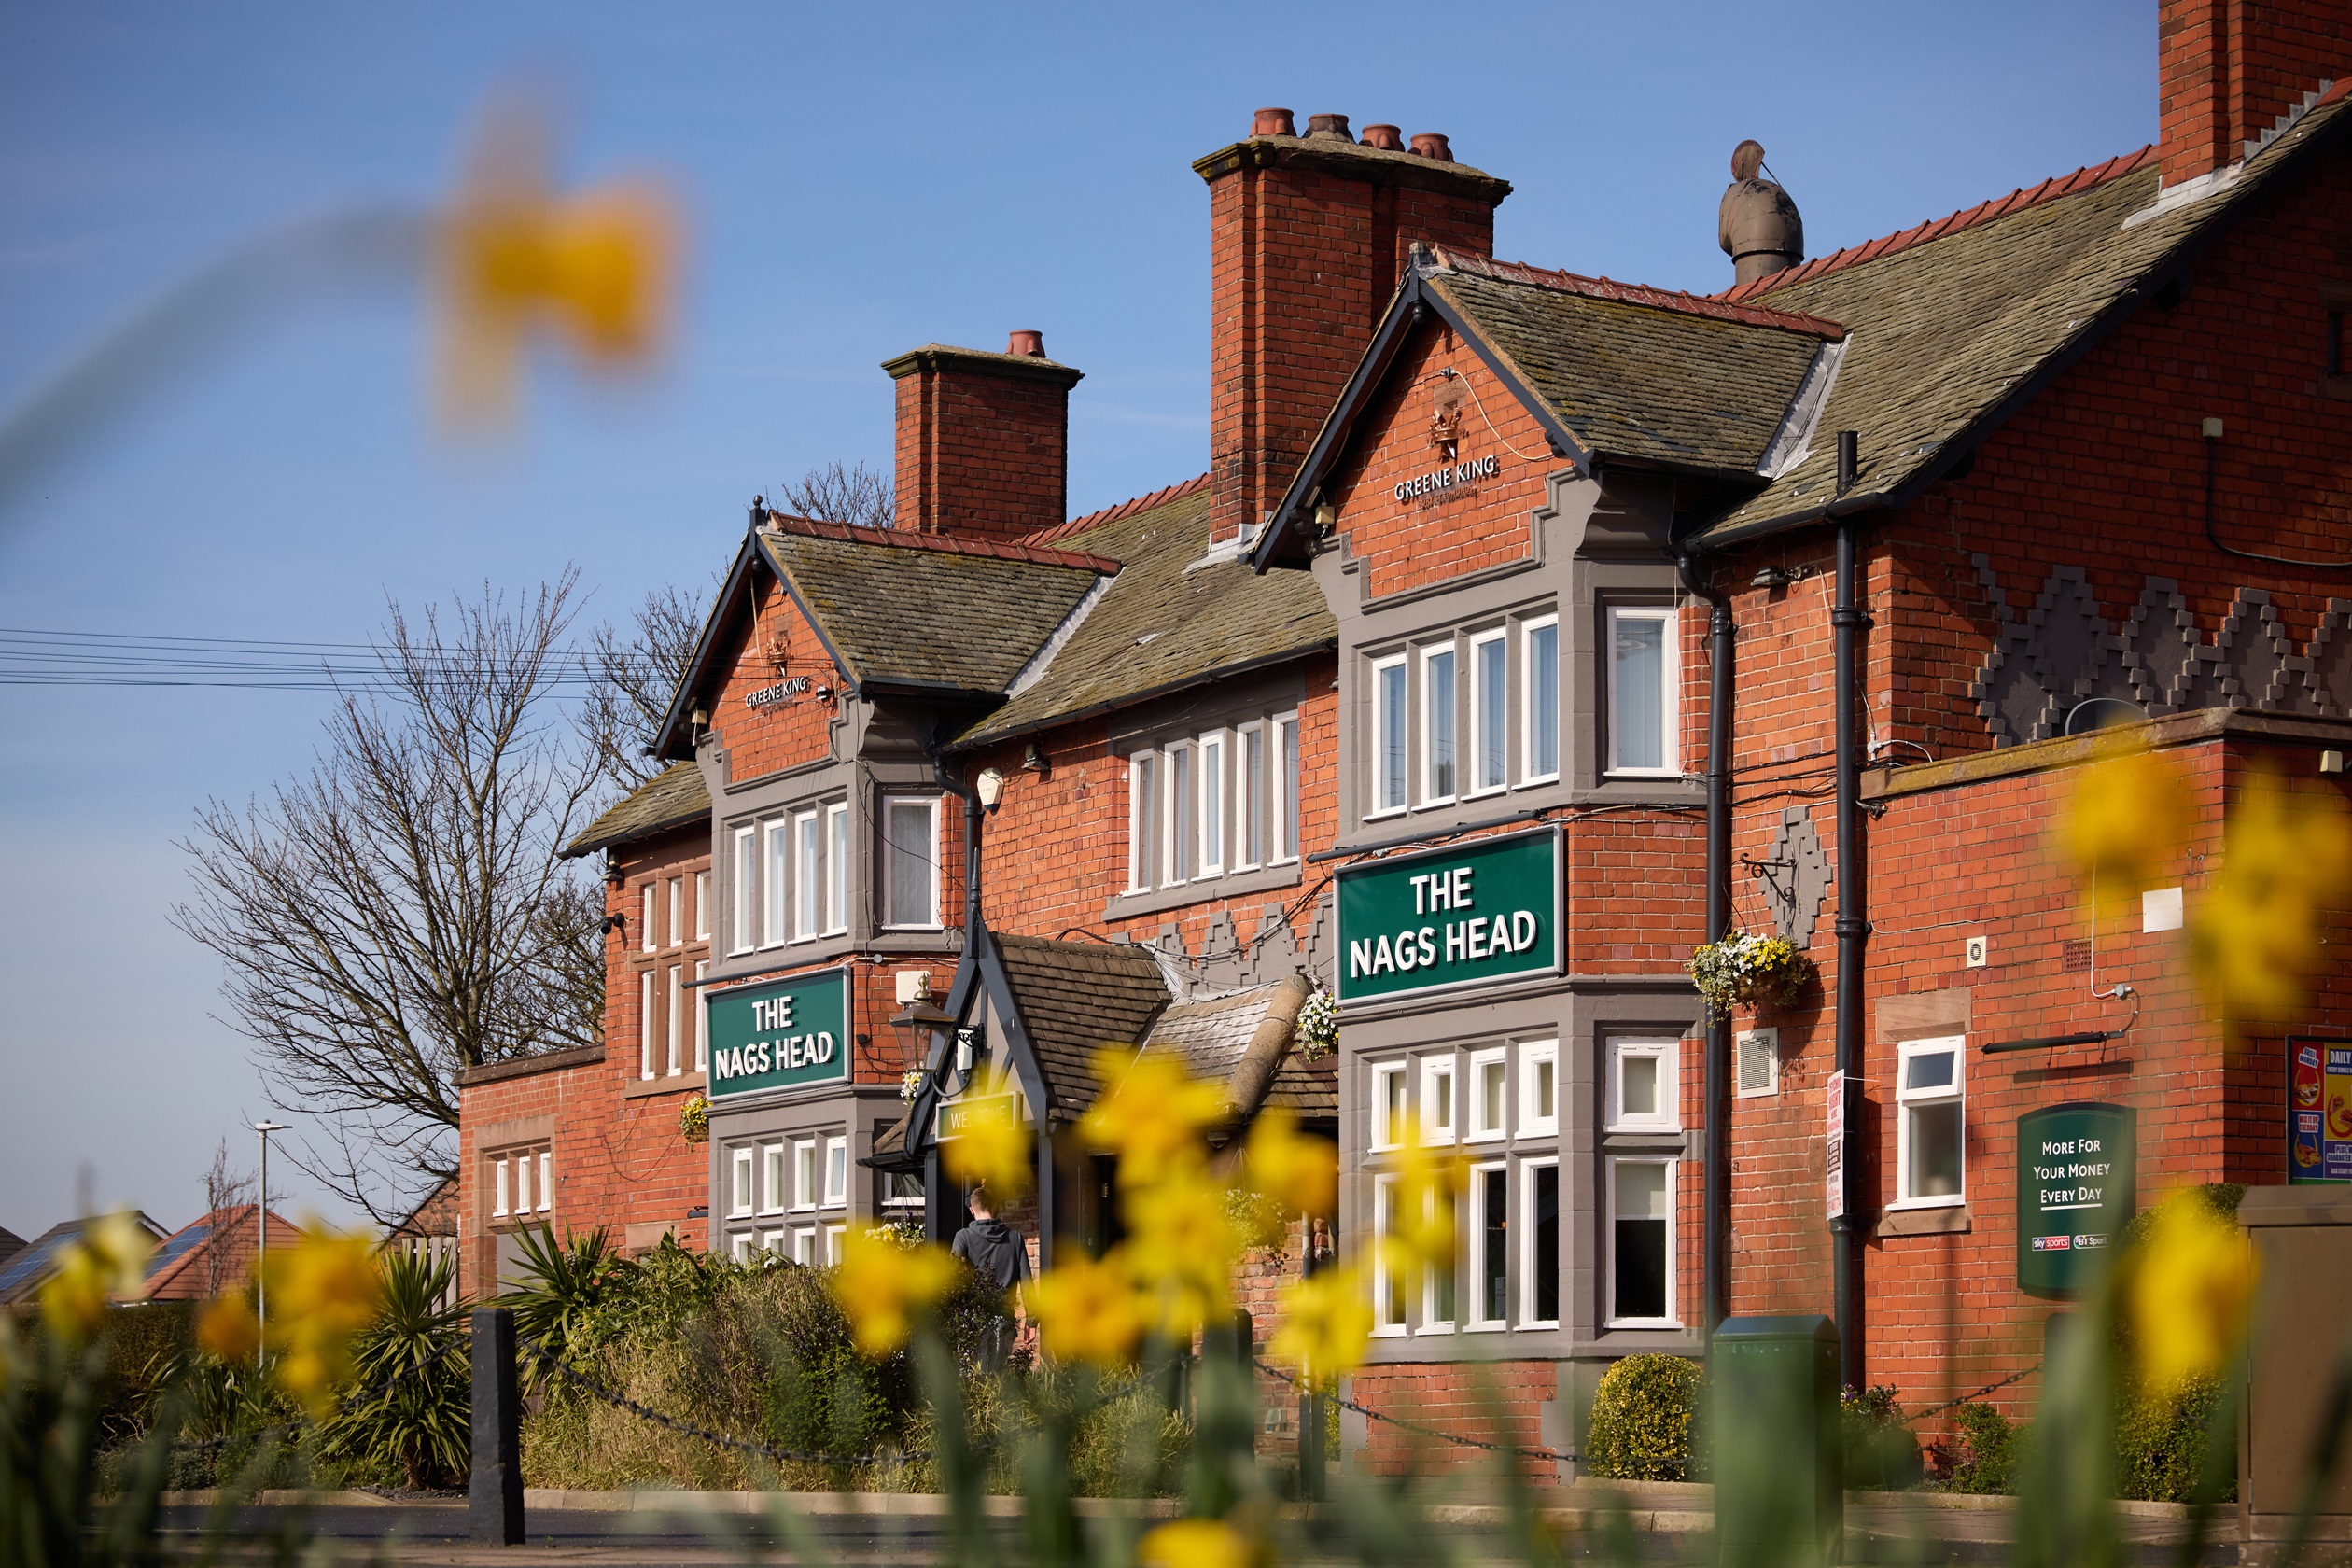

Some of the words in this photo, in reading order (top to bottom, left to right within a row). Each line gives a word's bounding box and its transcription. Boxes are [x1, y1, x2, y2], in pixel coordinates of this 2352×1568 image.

[1394, 467, 1452, 501] GREENE
[1456, 455, 1495, 483] KING
[746, 684, 782, 707] GREENE
[784, 677, 806, 697] KING
[1409, 866, 1473, 915] THE
[1351, 927, 1437, 978] NAGS
[1446, 910, 1537, 962] HEAD
[752, 995, 793, 1032] THE
[715, 1042, 772, 1081] NAGS
[776, 1031, 834, 1071] HEAD
[2299, 1055, 2318, 1068] MONDAY
[2330, 1051, 2352, 1064] DAILY
[2300, 1124, 2318, 1132] TUESDAY
[2042, 1141, 2075, 1155] MORE
[2079, 1139, 2101, 1153] FOR
[2034, 1166, 2065, 1180] YOUR
[2068, 1163, 2110, 1178] MONEY
[2040, 1189, 2076, 1204] EVERY
[2079, 1187, 2102, 1201] DAY
[2034, 1239, 2045, 1249] sky
[2046, 1239, 2068, 1249] sports
[2078, 1237, 2088, 1246] BT
[2089, 1236, 2107, 1246] Sport
